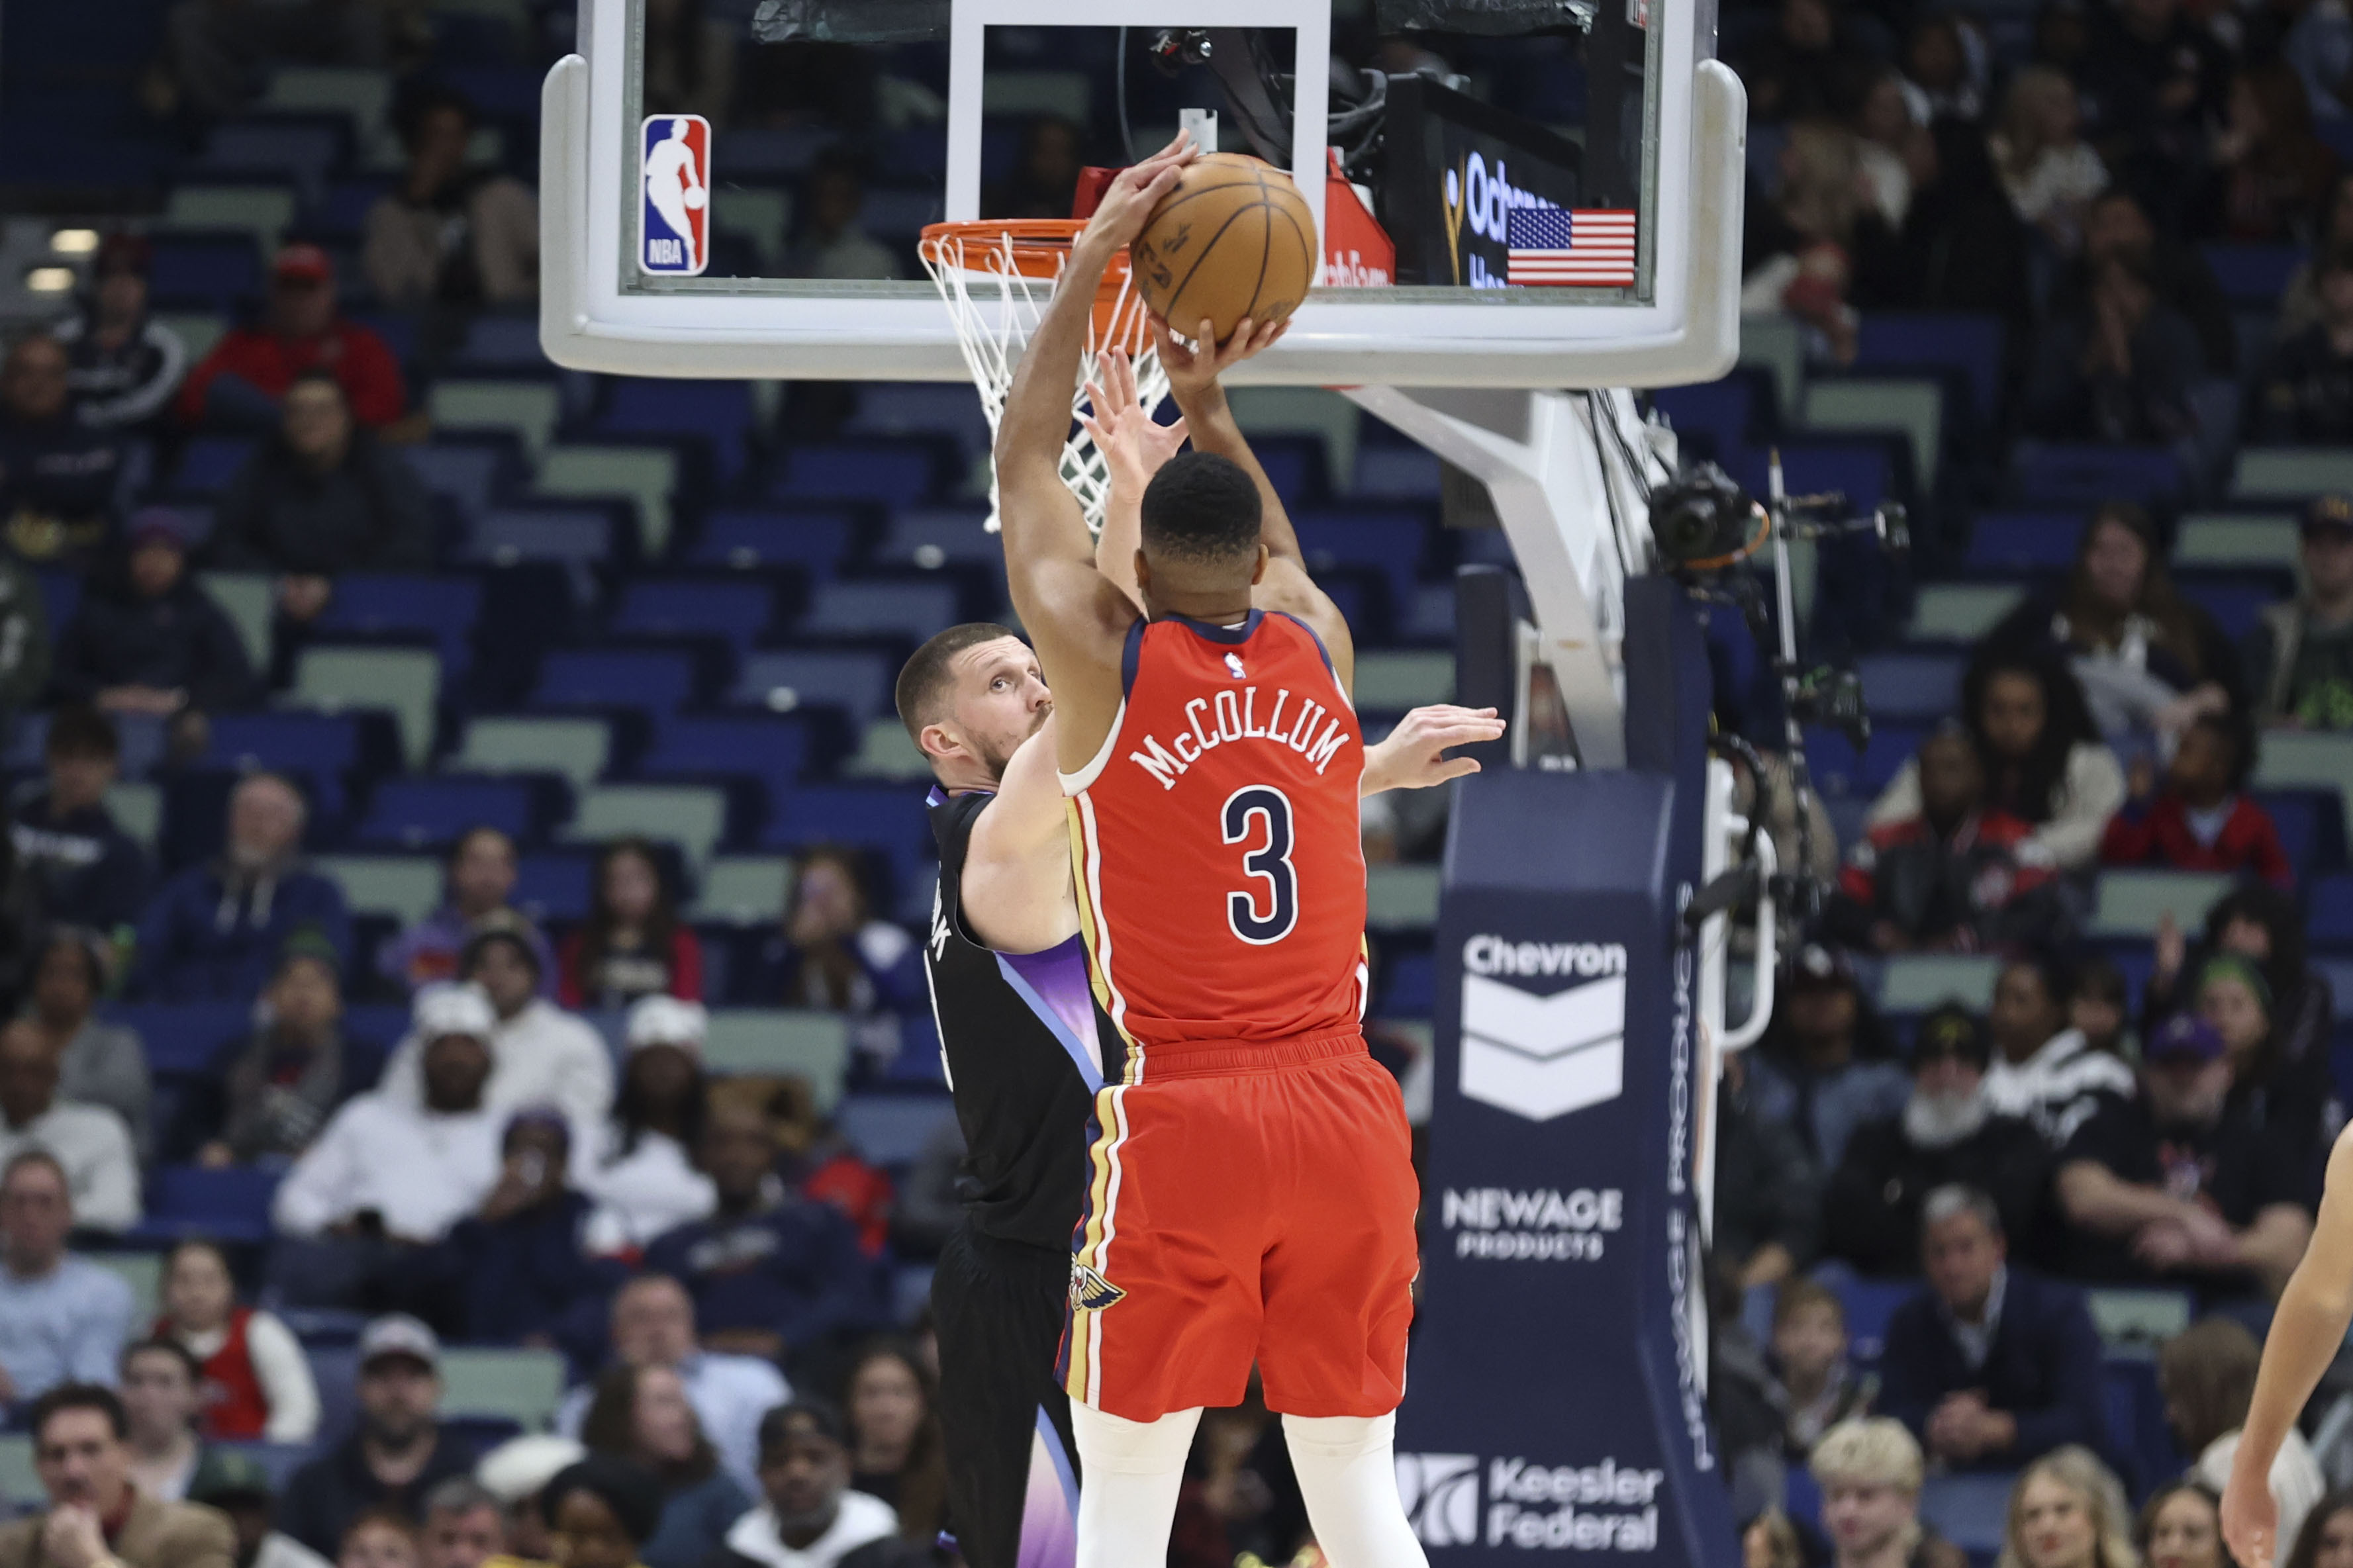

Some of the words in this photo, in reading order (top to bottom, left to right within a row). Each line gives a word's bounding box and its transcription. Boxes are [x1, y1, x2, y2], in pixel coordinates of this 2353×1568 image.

[649, 238, 683, 264] NBA
[1129, 686, 1350, 790] McCOLLUM
[1220, 784, 1298, 945] 3
[1464, 936, 1626, 974] Chevron
[1442, 1188, 1623, 1230] NEWAGE
[1456, 1232, 1604, 1262] PRODUCTS
[1488, 1456, 1664, 1504] Keesler
[1487, 1503, 1658, 1550] Federal
